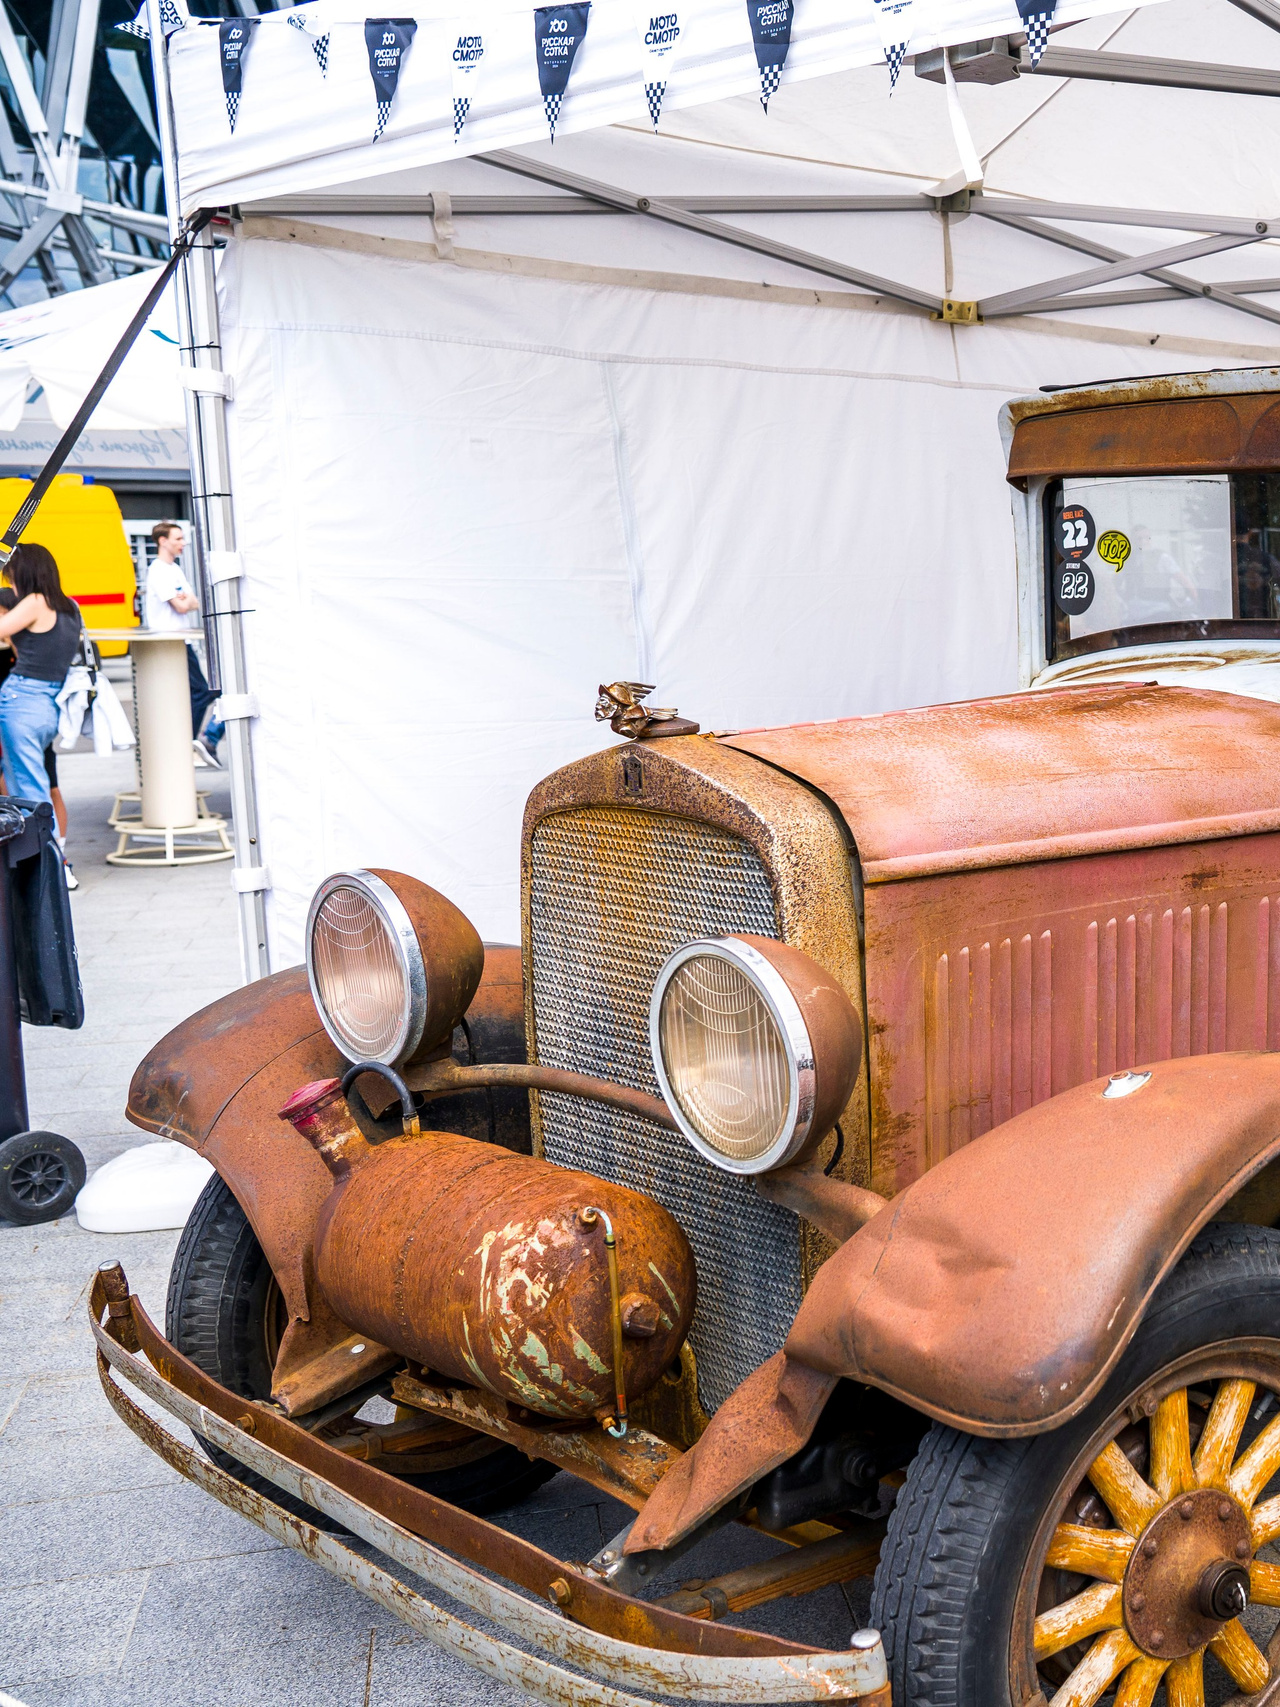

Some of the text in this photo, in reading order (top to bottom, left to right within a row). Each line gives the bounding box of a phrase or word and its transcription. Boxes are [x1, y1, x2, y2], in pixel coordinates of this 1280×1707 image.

[757, 0, 790, 18] РУССКАЯ
[649, 13, 678, 32] МОТО
[761, 11, 788, 26] СОТКА
[457, 36, 482, 49] МОТО
[541, 36, 575, 48] РУССКАЯ
[644, 27, 681, 46] СМОТР
[374, 47, 401, 59] РУССКАЯ
[452, 49, 484, 62] СМОТР
[544, 46, 569, 57] СОТКА
[377, 57, 397, 67] СОТКА
[1062, 519, 1089, 549] 22
[1102, 538, 1128, 560] TOP
[1060, 571, 1089, 600] 22
